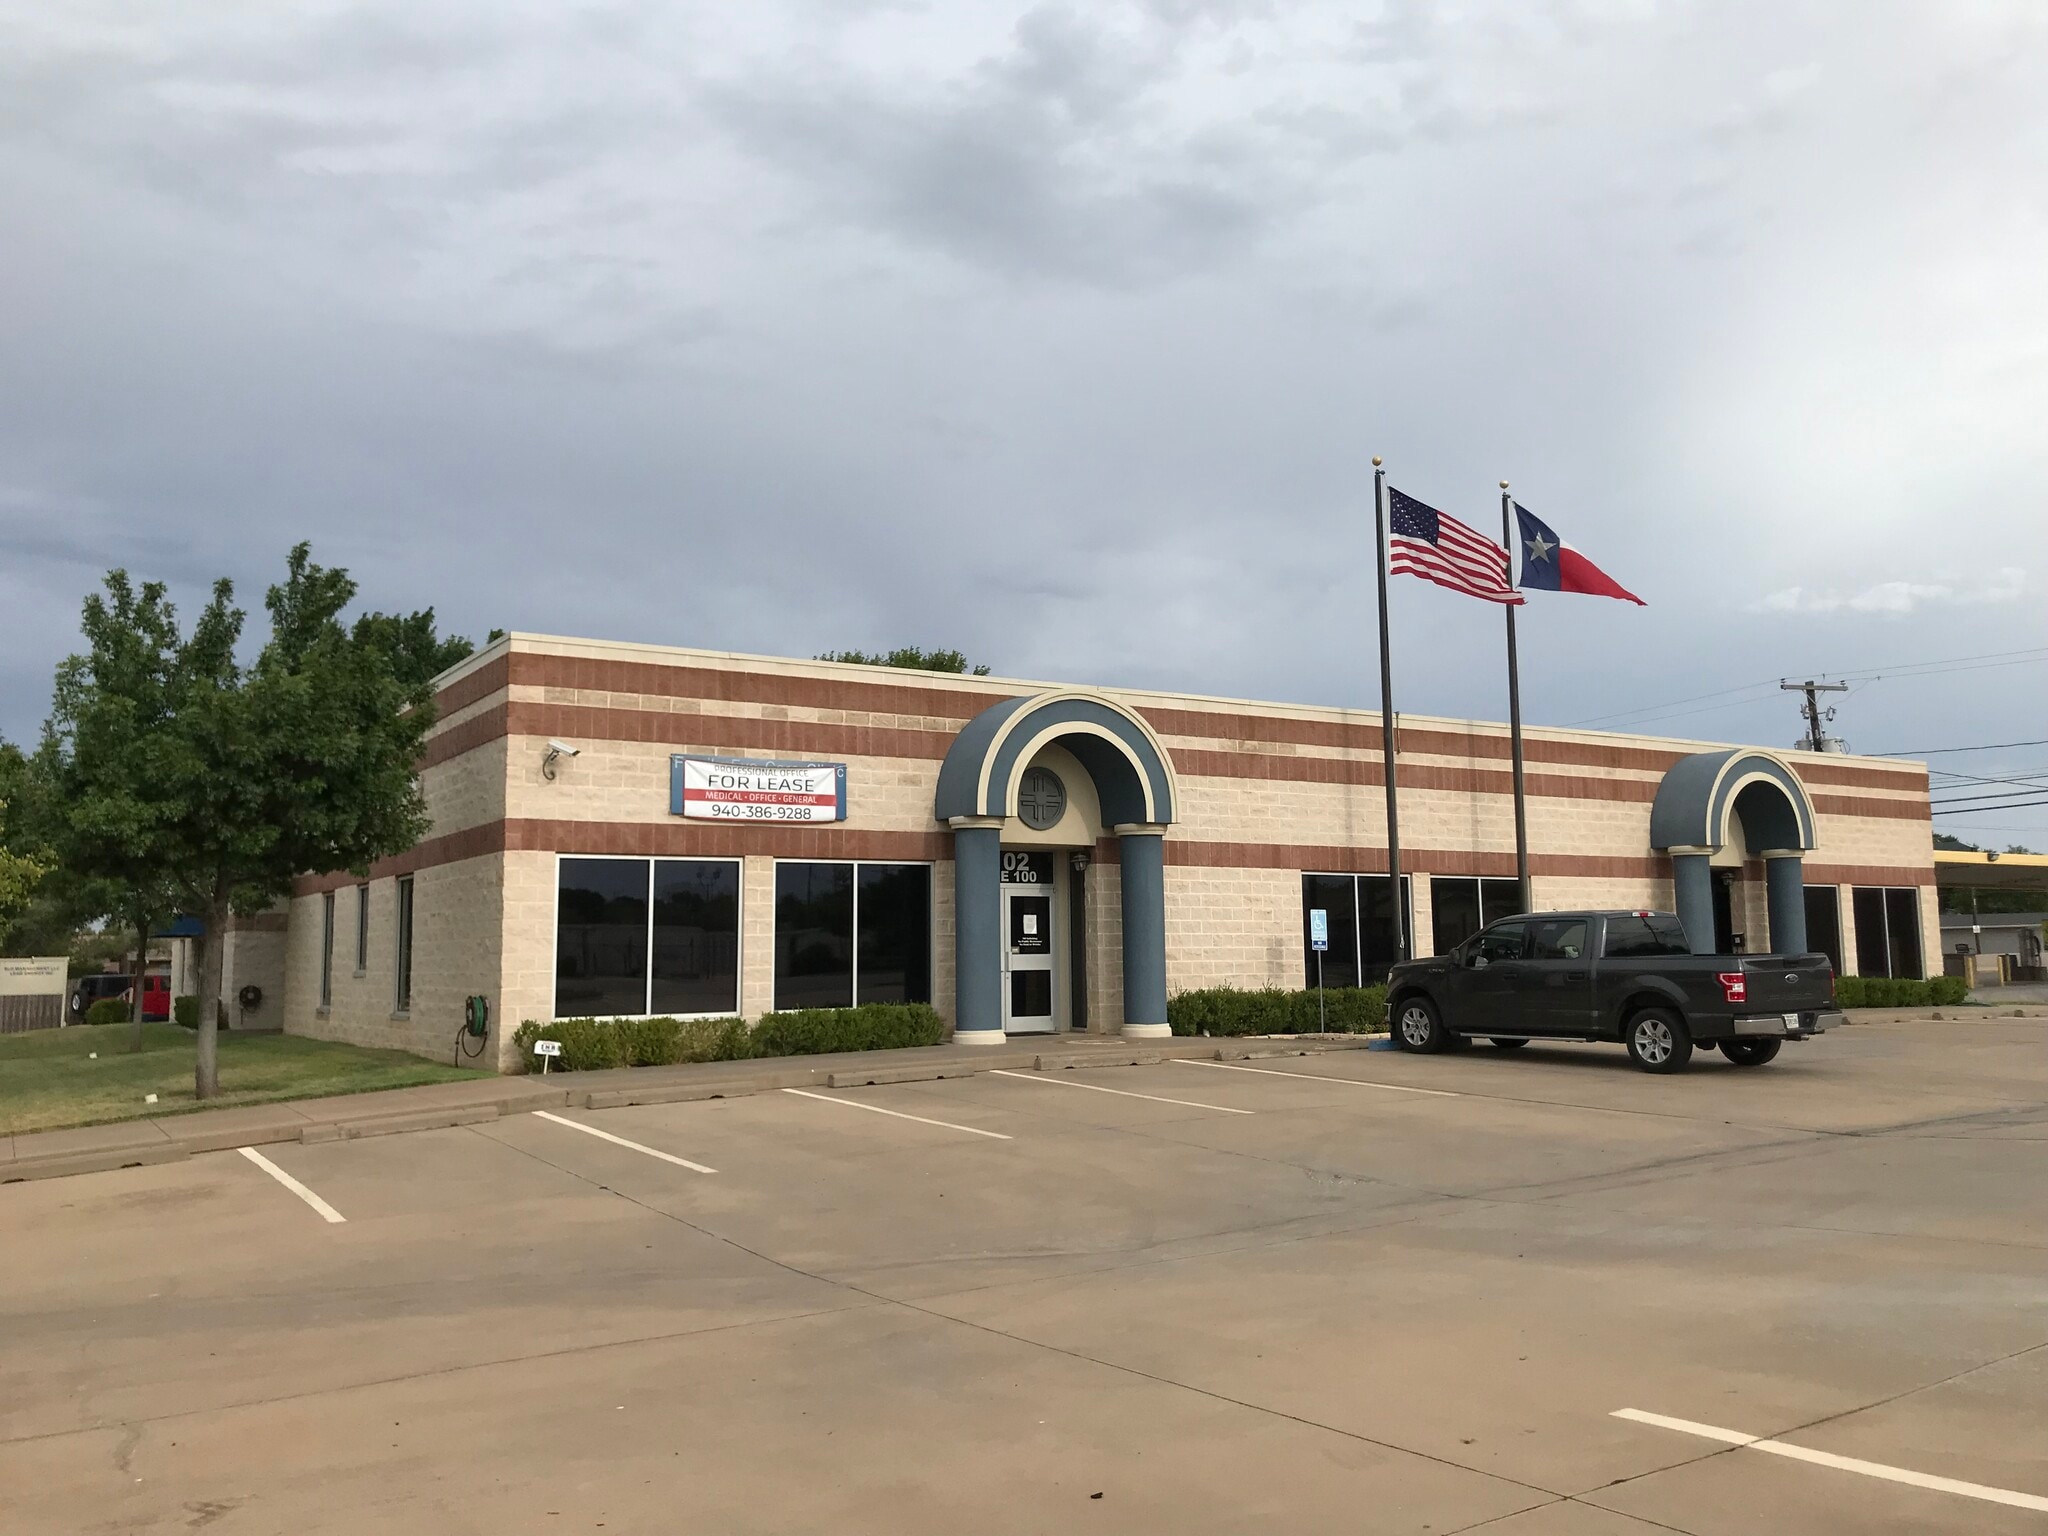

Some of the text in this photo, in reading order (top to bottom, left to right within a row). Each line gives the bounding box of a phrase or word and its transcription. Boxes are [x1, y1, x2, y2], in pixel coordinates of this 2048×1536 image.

[714, 765, 808, 778] PROFESSIONAL OFFICE
[708, 775, 815, 792] FOR LEASE
[705, 791, 817, 804] MEDICAL OFFICE GENERAL
[711, 804, 812, 820] 940-386-9288
[1013, 870, 1037, 882] 100
